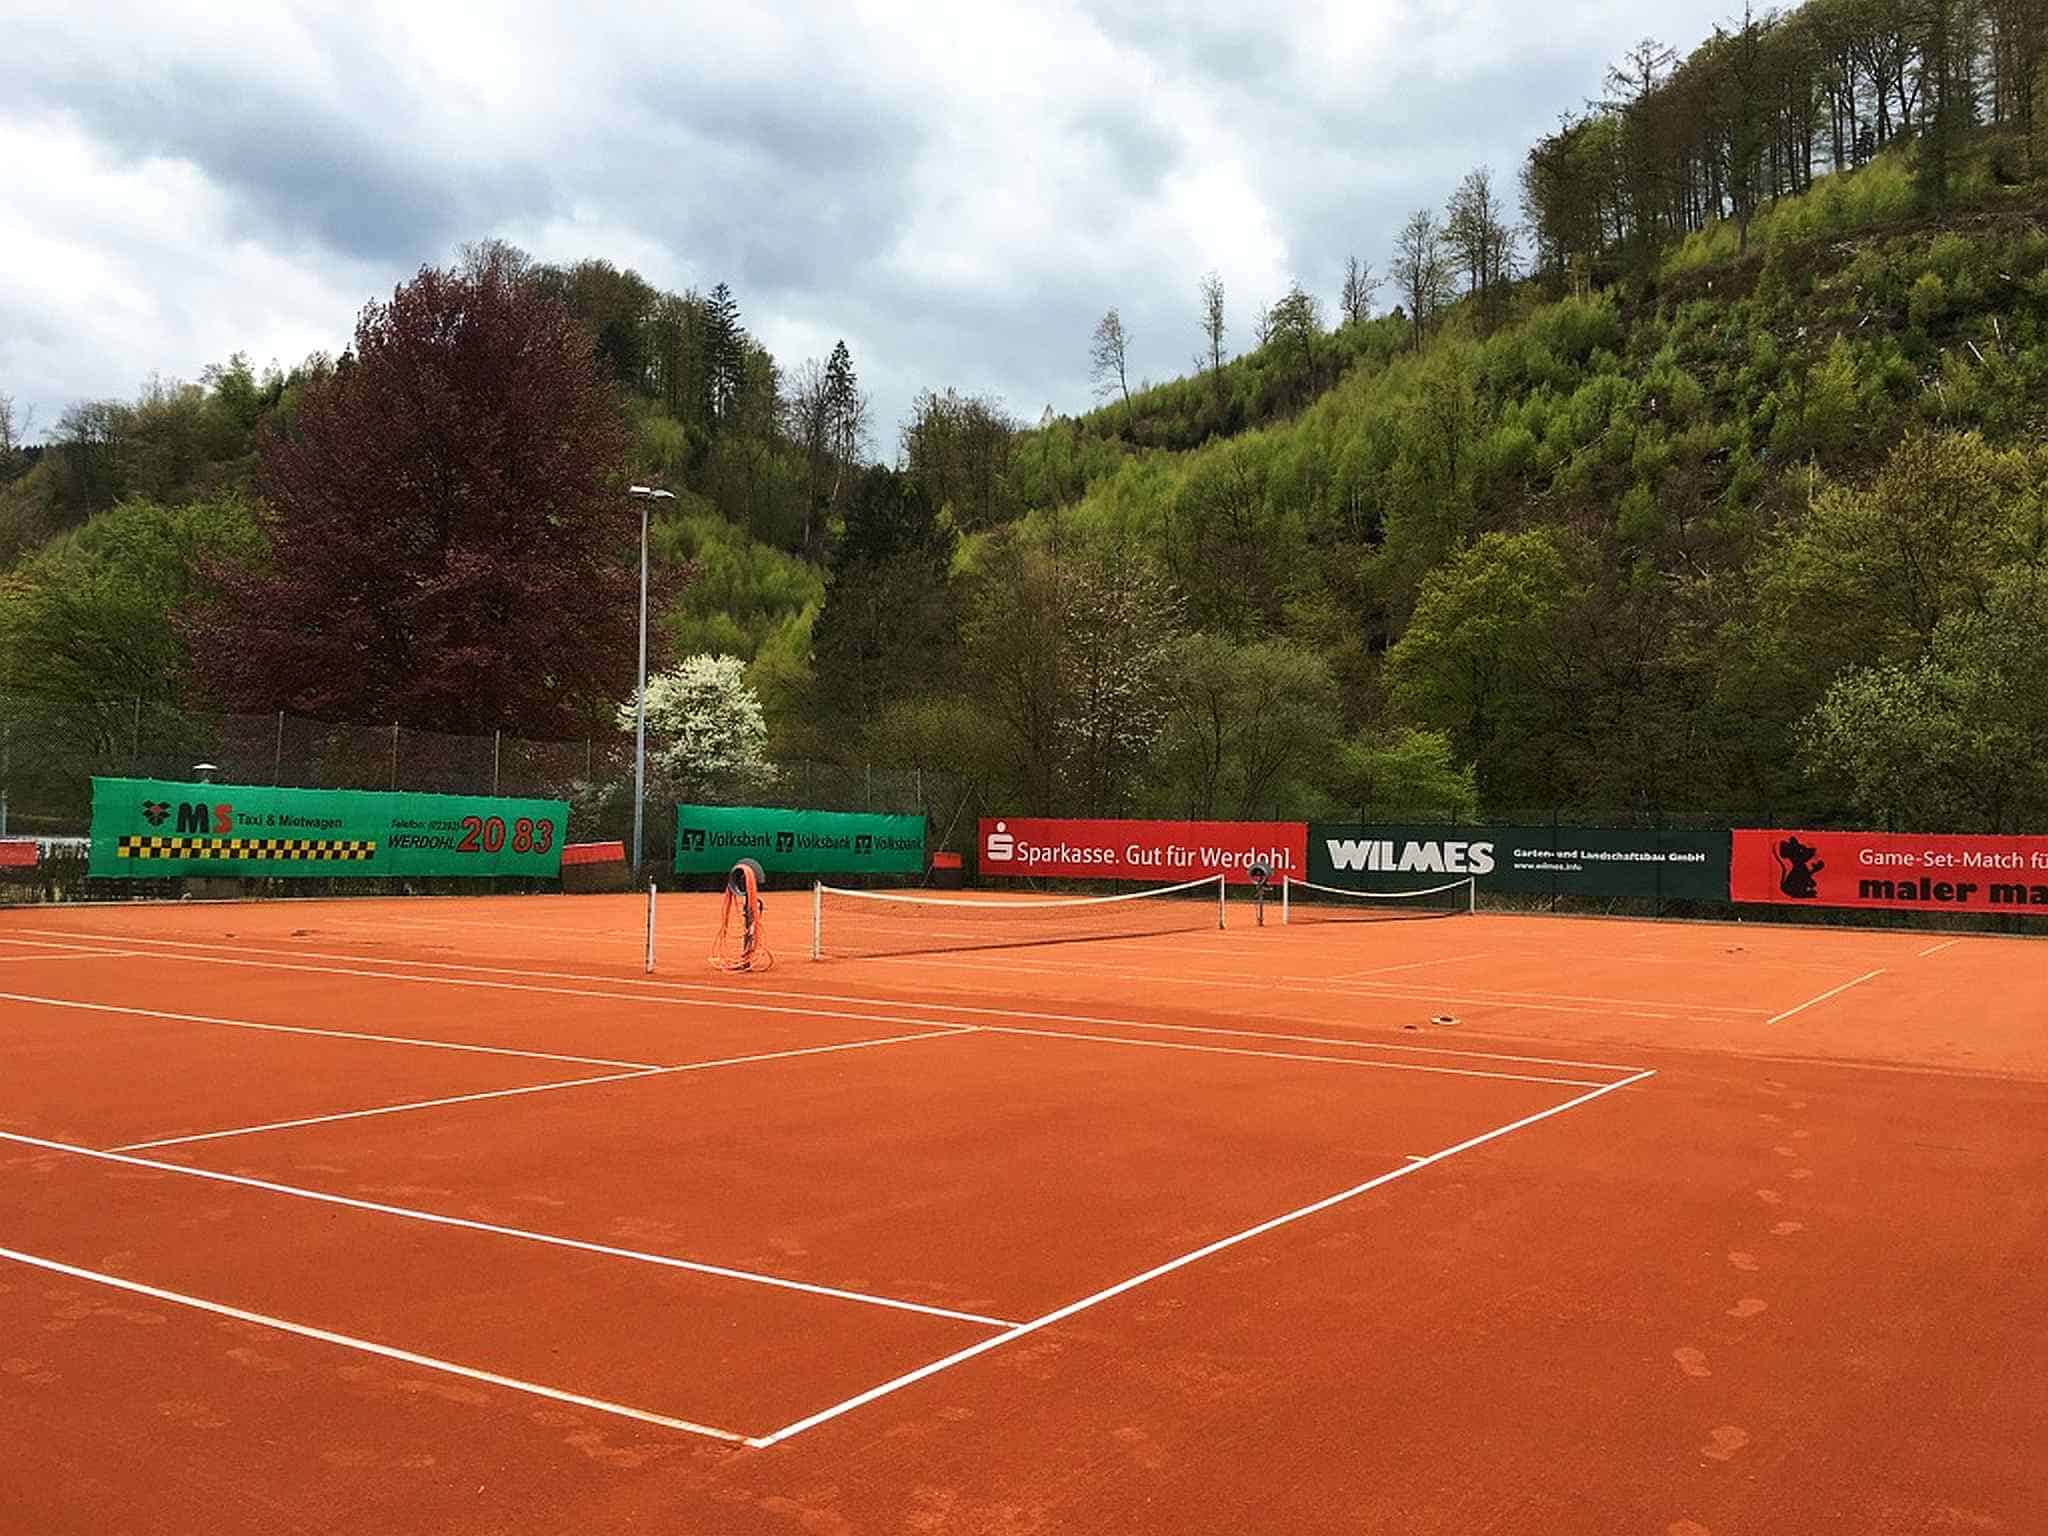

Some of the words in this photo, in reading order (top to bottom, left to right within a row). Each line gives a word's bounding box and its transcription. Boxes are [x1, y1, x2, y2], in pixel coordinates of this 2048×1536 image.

[176, 802, 233, 835] MS
[237, 813, 262, 826] Taxi
[266, 814, 275, 826] &
[279, 814, 342, 830] Mietwagen
[388, 835, 456, 849] WERDOHL
[456, 816, 505, 853] 20
[512, 818, 553, 853] 83
[709, 831, 771, 848] Volksbank
[798, 834, 850, 849] Volksbank
[874, 837, 922, 850] Volksbank
[1017, 842, 1120, 866] Sparkasse.
[1126, 845, 1161, 865] Gut
[1167, 846, 1197, 867] für
[1200, 847, 1297, 869] Werdohl.
[1326, 839, 1495, 874] WILMES
[1513, 849, 1555, 858] Garten-
[1556, 849, 1578, 859] und
[1580, 850, 1665, 862] Landschaftsbau
[1669, 852, 1705, 862] GmbH
[1859, 849, 2024, 869] Game-Set-Match
[1858, 877, 1977, 903] maler
